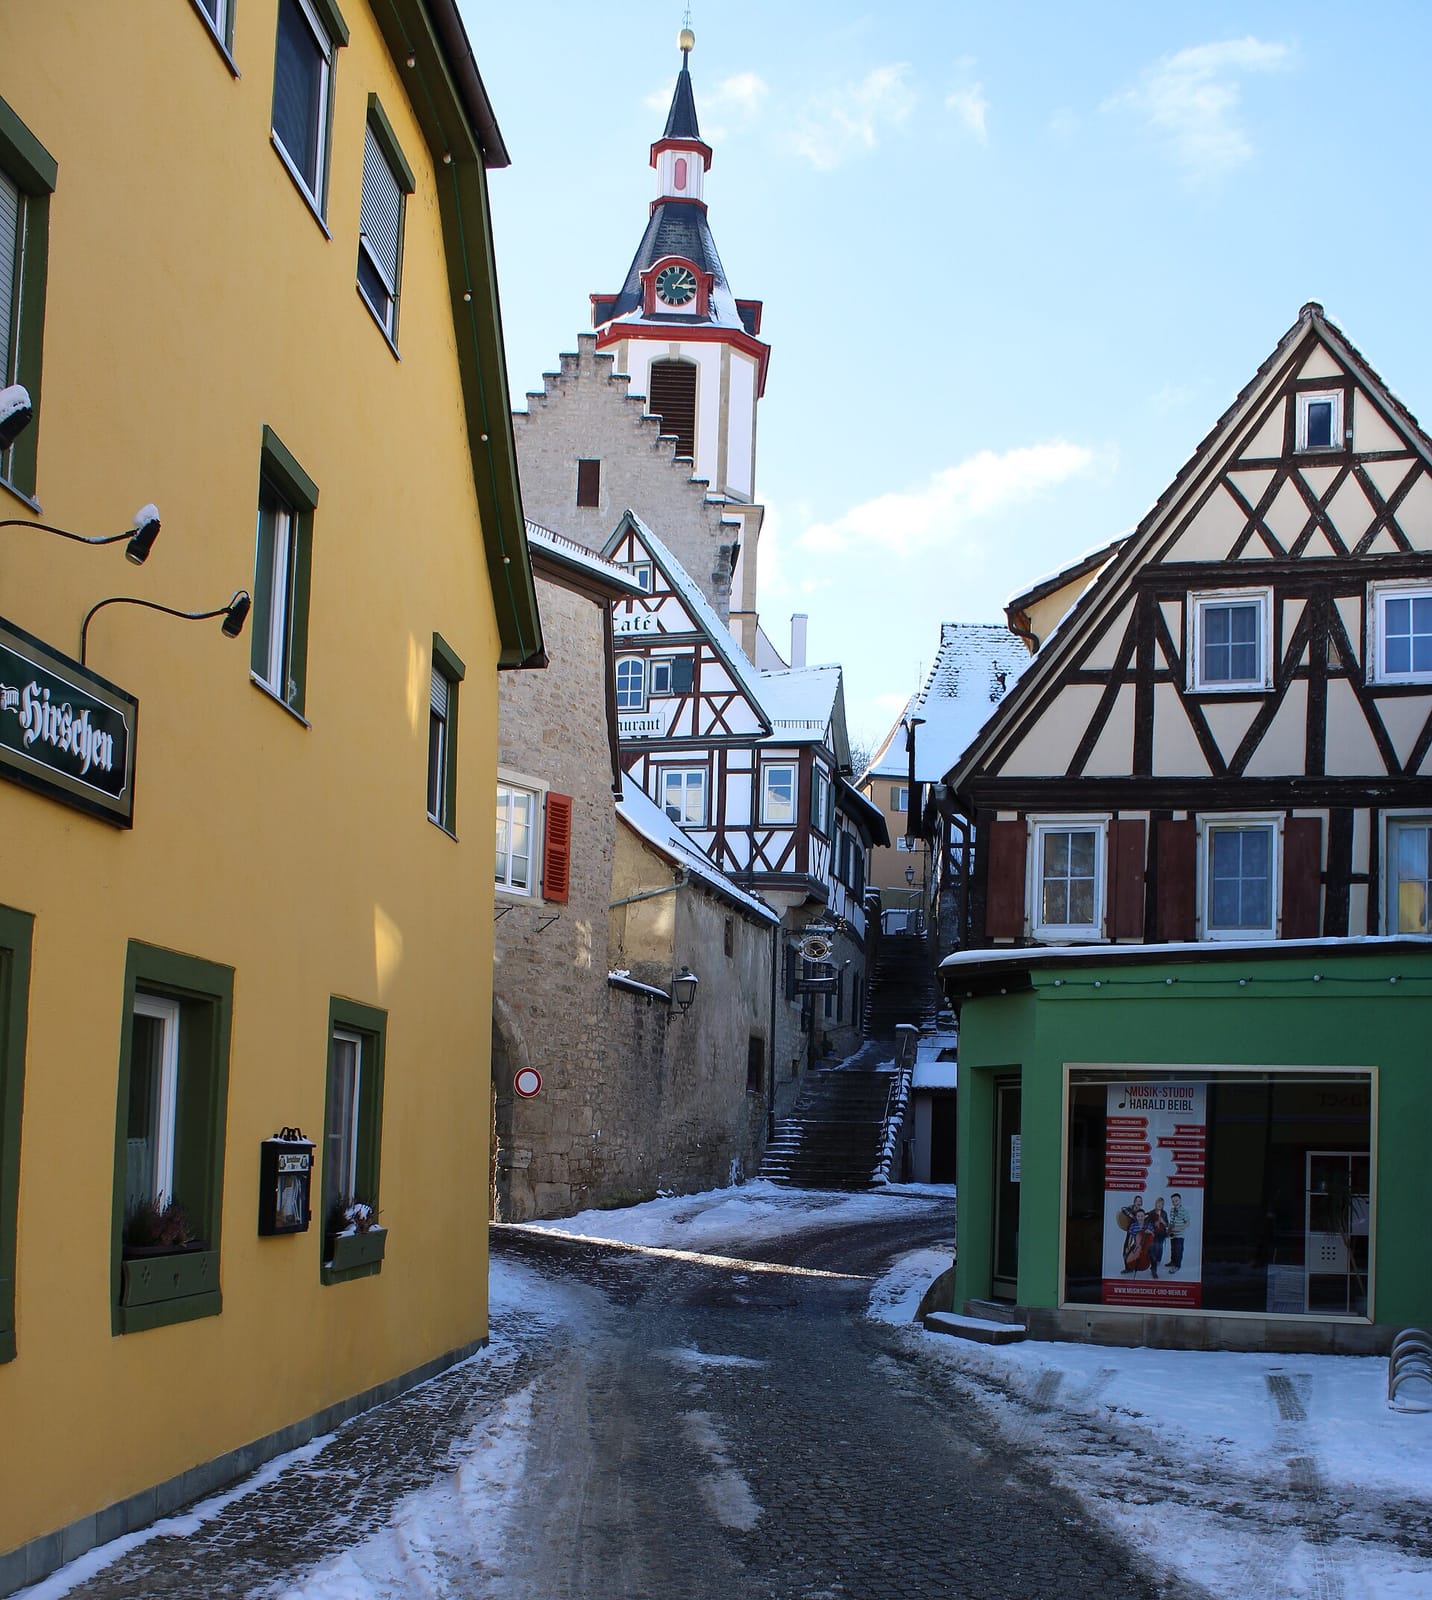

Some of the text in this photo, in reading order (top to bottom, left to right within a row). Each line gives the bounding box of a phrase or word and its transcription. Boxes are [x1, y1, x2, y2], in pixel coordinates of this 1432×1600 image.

[19, 680, 113, 775] Hirschen
[1130, 1086, 1194, 1099] MUSIK-STUDIO
[1129, 1098, 1194, 1111] HARALD BEIBL
